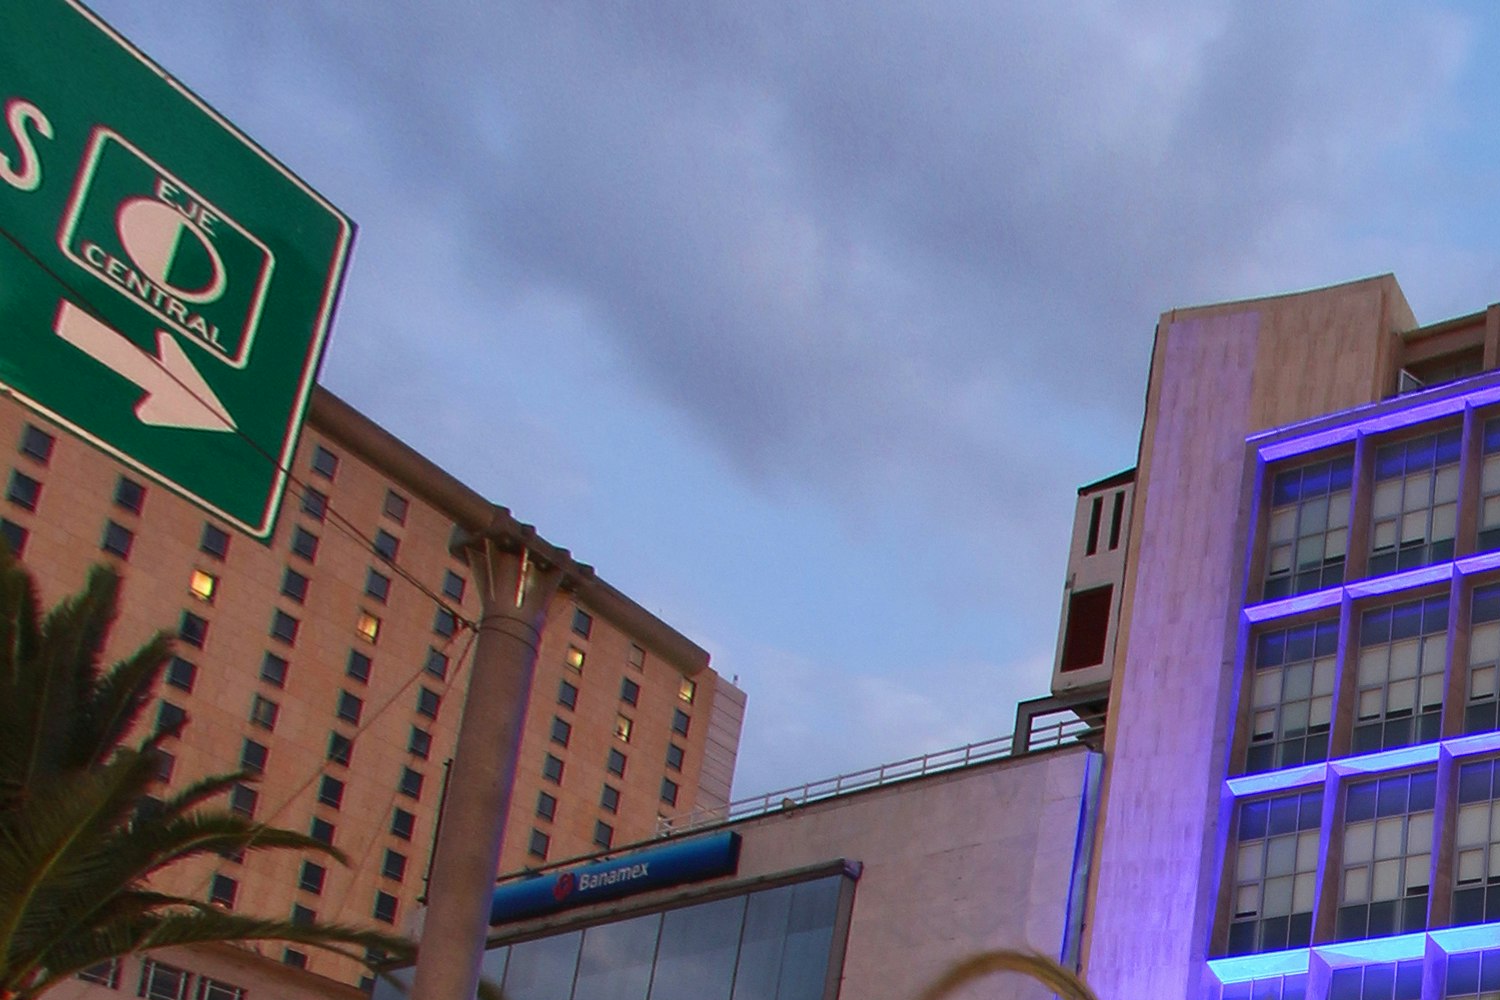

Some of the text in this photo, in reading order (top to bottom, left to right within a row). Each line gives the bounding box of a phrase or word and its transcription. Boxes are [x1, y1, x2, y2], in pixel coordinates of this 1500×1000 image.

[157, 177, 221, 238] EJE
[83, 242, 228, 353] CENTRAL
[578, 862, 649, 891] Banamex
